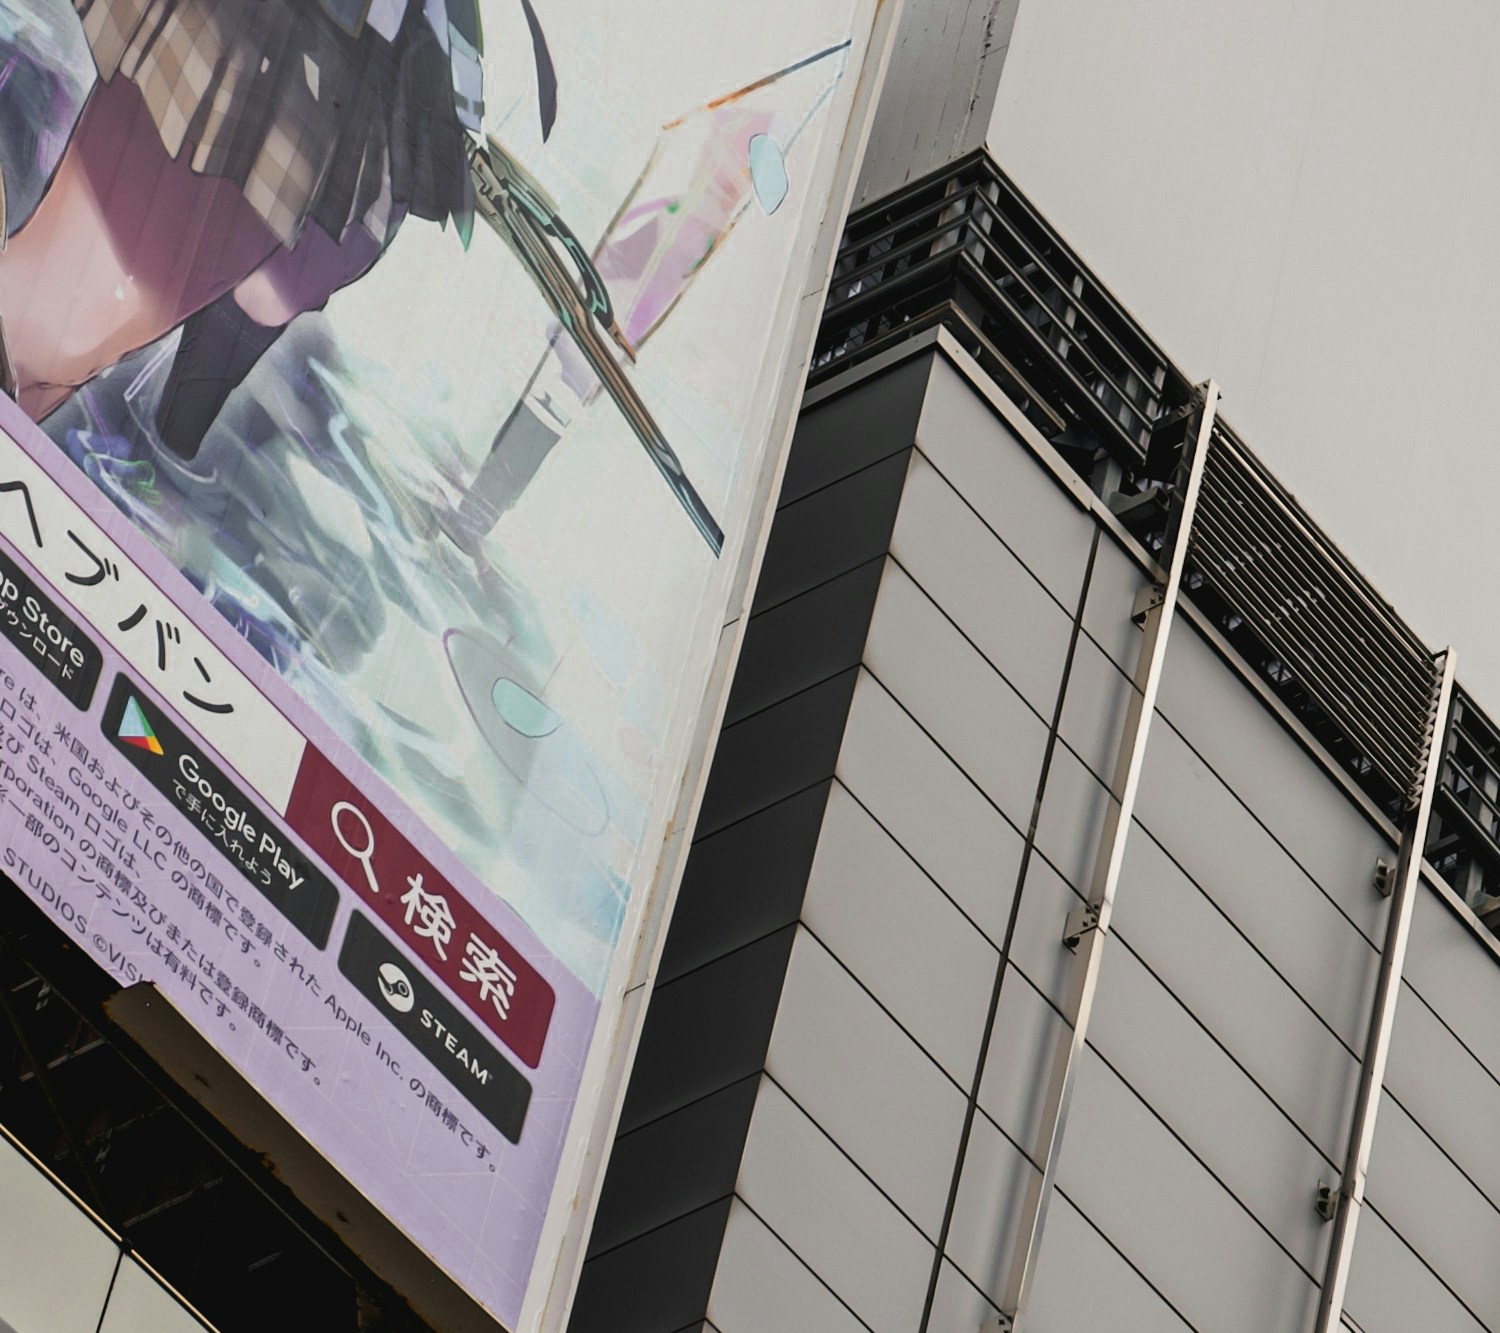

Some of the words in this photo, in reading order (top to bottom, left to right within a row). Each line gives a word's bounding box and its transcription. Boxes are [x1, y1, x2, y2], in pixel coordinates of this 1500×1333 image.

[0, 481, 234, 713] ヘブバン
[23, 596, 84, 668] Store
[27, 755, 79, 816] Steam
[85, 813, 141, 879] ロゴは、
[69, 766, 128, 833] Google
[133, 829, 167, 870] LLC
[172, 870, 260, 967] の商標です。
[173, 778, 271, 885] で手に入れよう
[179, 754, 256, 843] Google
[259, 833, 304, 890] Play
[4, 847, 87, 934] STUDIOS
[401, 873, 517, 1020] 検索
[80, 838, 321, 1086] の商標及びまたは登録商標です。
[324, 994, 371, 1046] Apple
[375, 1042, 403, 1080] Inc.
[409, 1078, 496, 1173] の商標です。
